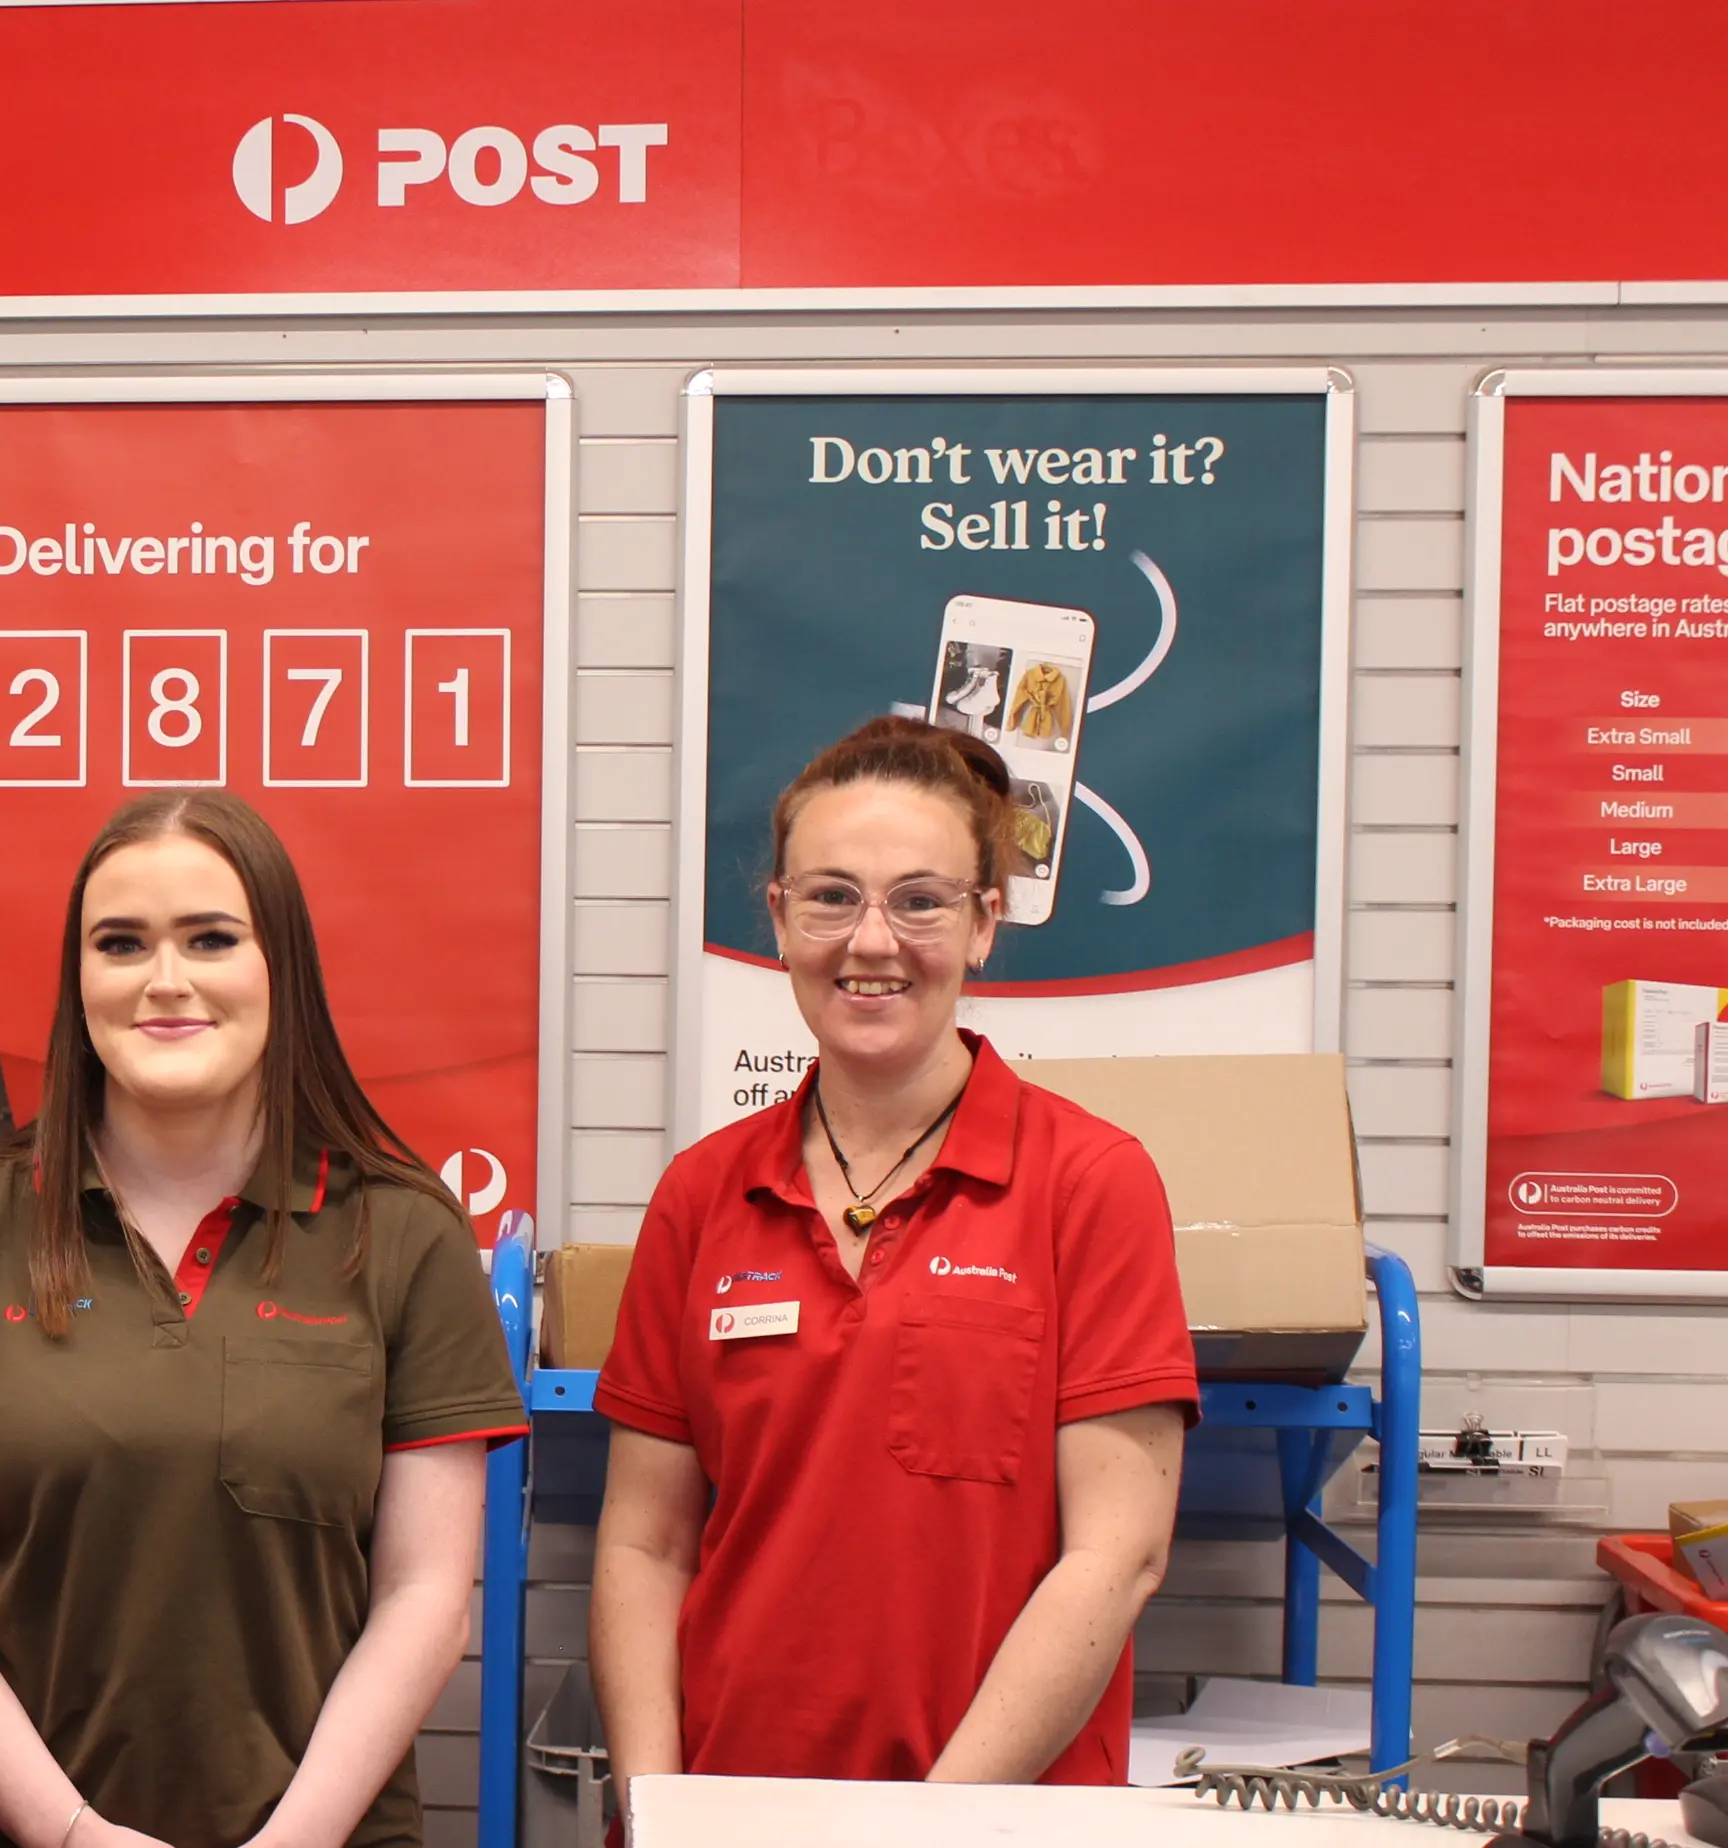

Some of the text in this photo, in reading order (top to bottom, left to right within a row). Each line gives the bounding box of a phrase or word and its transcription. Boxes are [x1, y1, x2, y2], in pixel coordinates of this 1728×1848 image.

[378, 123, 668, 206] POST
[984, 447, 1136, 485] wear
[1149, 434, 1225, 485] it?
[920, 500, 1107, 551] Sell it!
[287, 521, 370, 574] for
[1544, 593, 1585, 613] Flat
[1590, 593, 1677, 617] postage
[1544, 617, 1647, 641] anywhere
[1652, 618, 1670, 637] in
[9, 668, 470, 747] 2 8 7 1
[1620, 690, 1661, 708] Size
[1587, 727, 1692, 745] Extra Small
[1611, 764, 1664, 782] Small
[1600, 801, 1674, 818] Medium
[1610, 838, 1662, 858] Large
[1583, 874, 1687, 895] Extra Large
[1613, 918, 1640, 929] cost
[1642, 917, 1653, 929] is
[1656, 918, 1675, 930] not
[1678, 918, 1728, 930] included
[734, 1083, 769, 1106] off
[1550, 1184, 1662, 1195] Australia Post is committed
[1550, 1195, 1661, 1206] to carbon neutral delivery
[952, 1265, 1018, 1283] Australia Post
[744, 1314, 788, 1326] CORRINA
